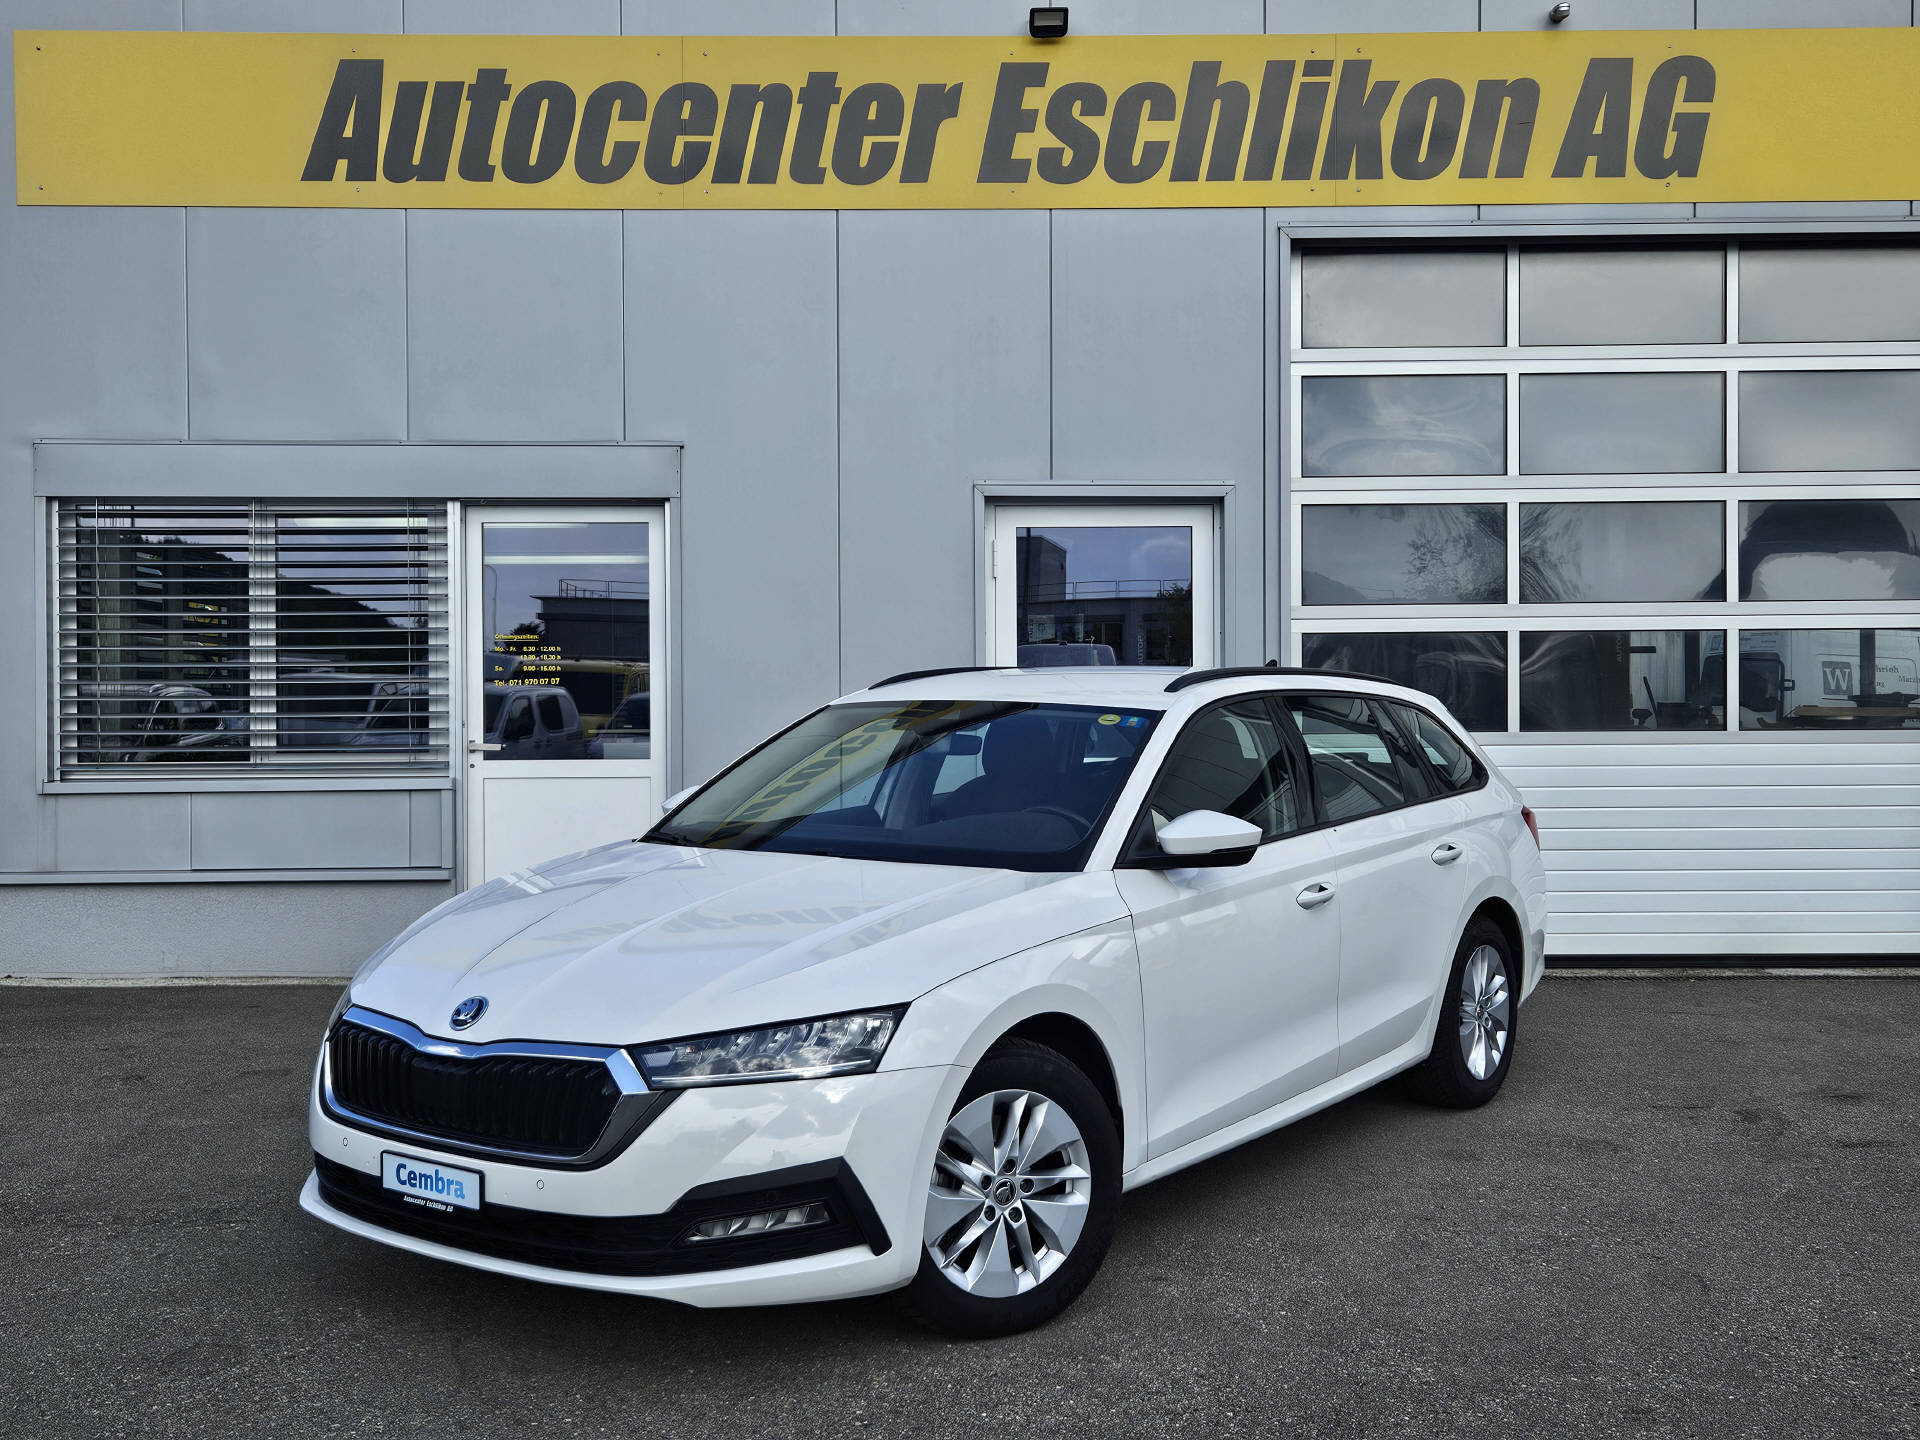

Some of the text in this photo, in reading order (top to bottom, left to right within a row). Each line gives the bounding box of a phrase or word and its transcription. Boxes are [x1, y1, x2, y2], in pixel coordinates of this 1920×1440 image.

[300, 54, 1717, 185] Autocenter Eschlikon AG
[509, 679, 522, 687] 071
[524, 678, 538, 686] 970
[550, 677, 560, 685] 07
[1823, 667, 1851, 690] W
[396, 1163, 465, 1199] Cembra
